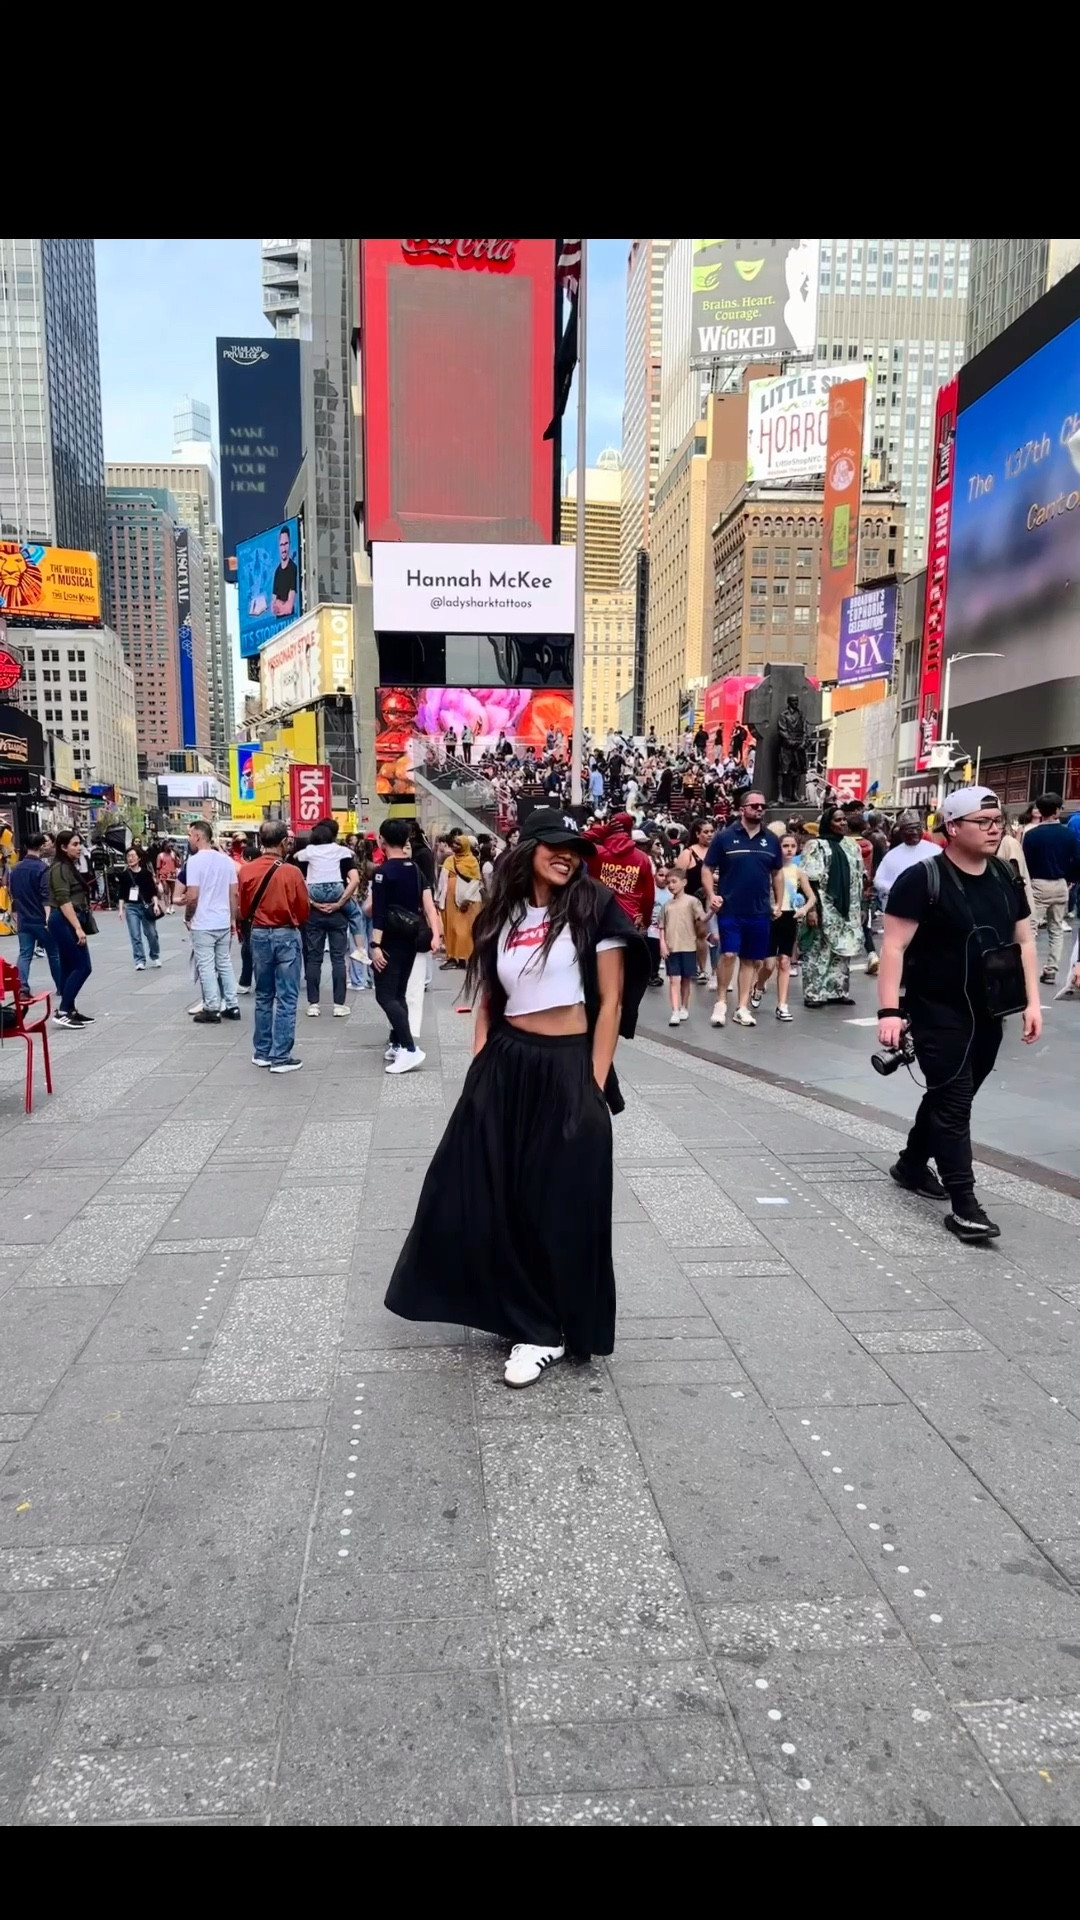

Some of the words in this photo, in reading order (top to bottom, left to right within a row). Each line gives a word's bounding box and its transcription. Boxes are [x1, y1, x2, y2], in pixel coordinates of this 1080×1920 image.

[703, 299, 740, 310] Brains.
[742, 296, 776, 307] Heart.
[715, 309, 762, 321] Courage.
[223, 350, 260, 358] PRIVILEGE
[760, 376, 817, 414] LITTLE
[230, 427, 264, 438] MAKE
[220, 445, 279, 457] THAILAND
[232, 463, 265, 474] YOUR
[230, 480, 265, 493] HOME
[969, 473, 994, 503] The
[50, 564, 62, 573] THE
[64, 566, 93, 577] WORLD'S
[58, 575, 95, 589] MUSICAL
[407, 569, 481, 587] Hannah
[489, 571, 552, 588] McKee
[52, 592, 62, 600] THE
[430, 596, 532, 609] @ladysharktattoos
[844, 633, 885, 671] SIX
[300, 769, 324, 821] tkts
[600, 869, 639, 880] DISCOVER
[601, 862, 640, 874] HOP-ON
[600, 874, 637, 887] HOP-OFF
